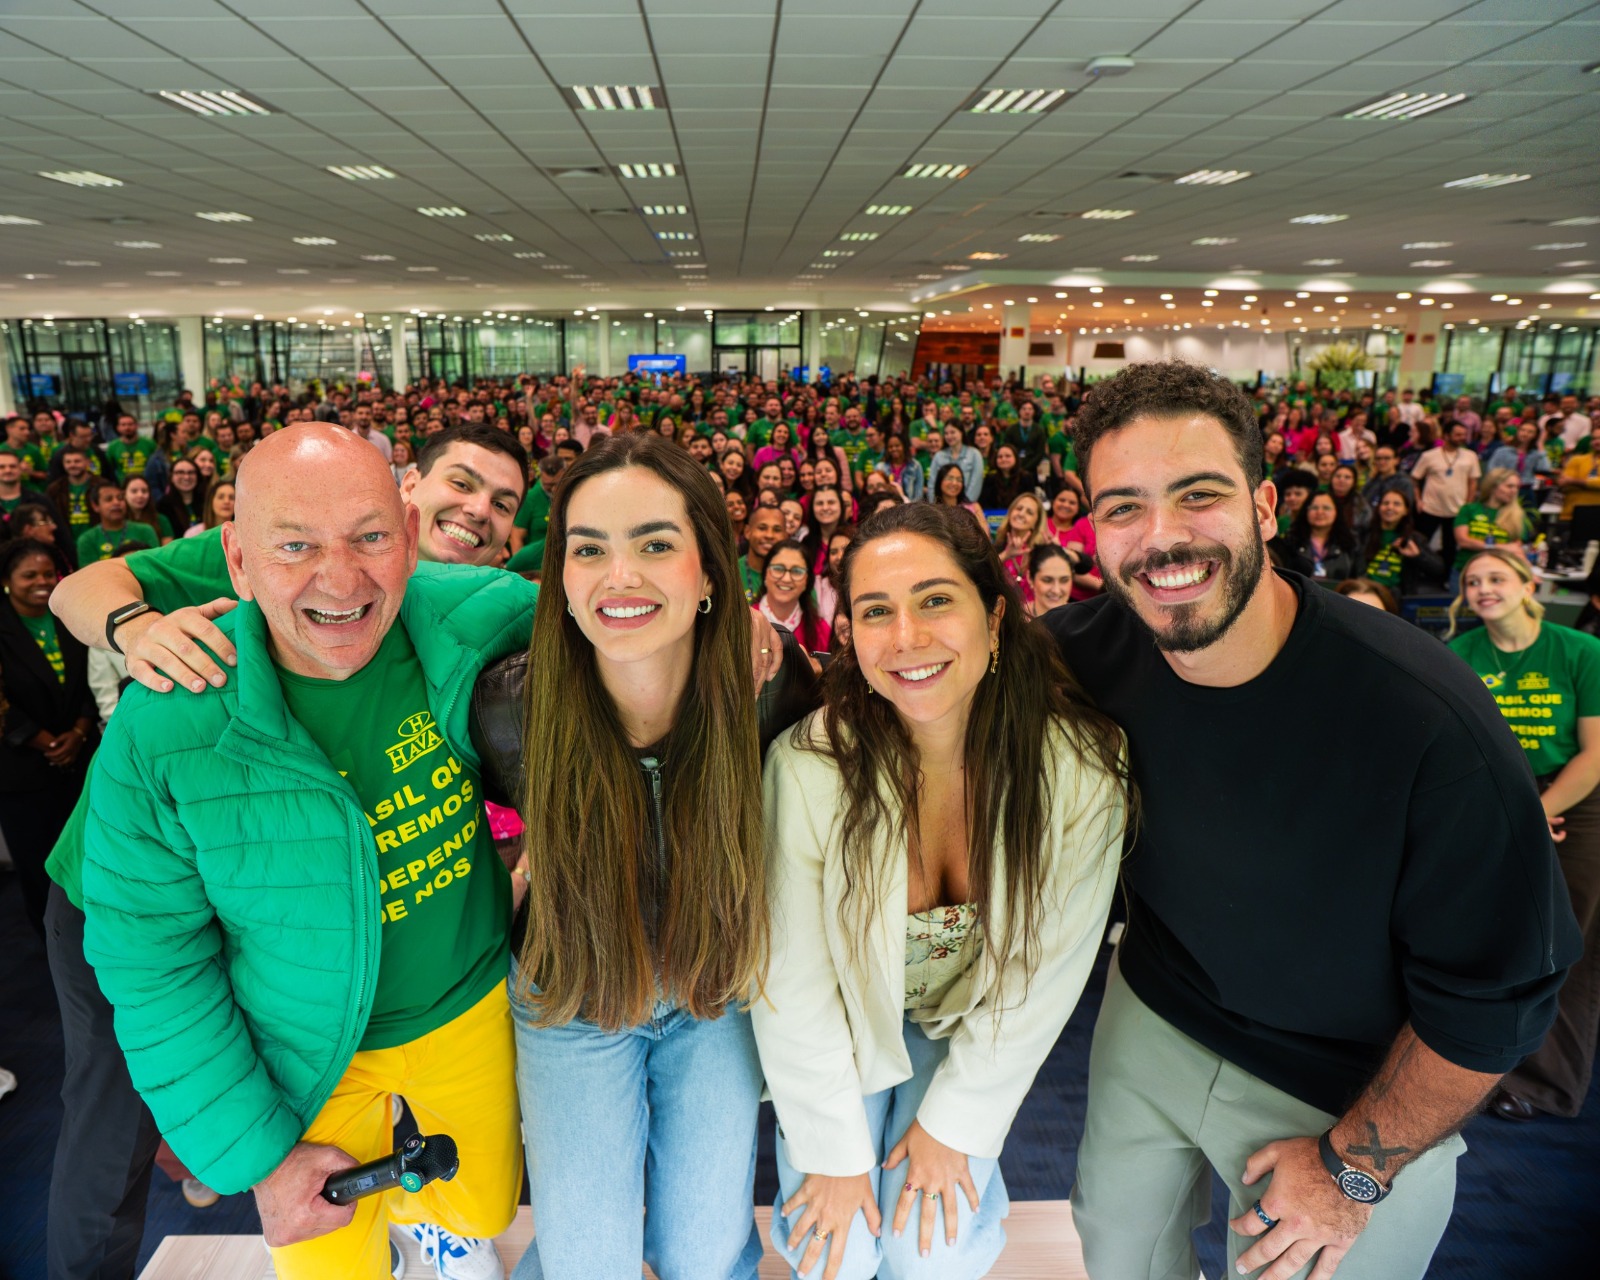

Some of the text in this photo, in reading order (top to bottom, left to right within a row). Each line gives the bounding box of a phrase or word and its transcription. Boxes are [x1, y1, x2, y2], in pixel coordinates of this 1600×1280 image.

[1493, 693, 1562, 705] ASIL QUE
[408, 715, 424, 733] H
[387, 729, 442, 769] HAVA
[1517, 737, 1540, 750] ÓS
[375, 779, 473, 854] REMOS
[415, 857, 471, 904] NÓS
